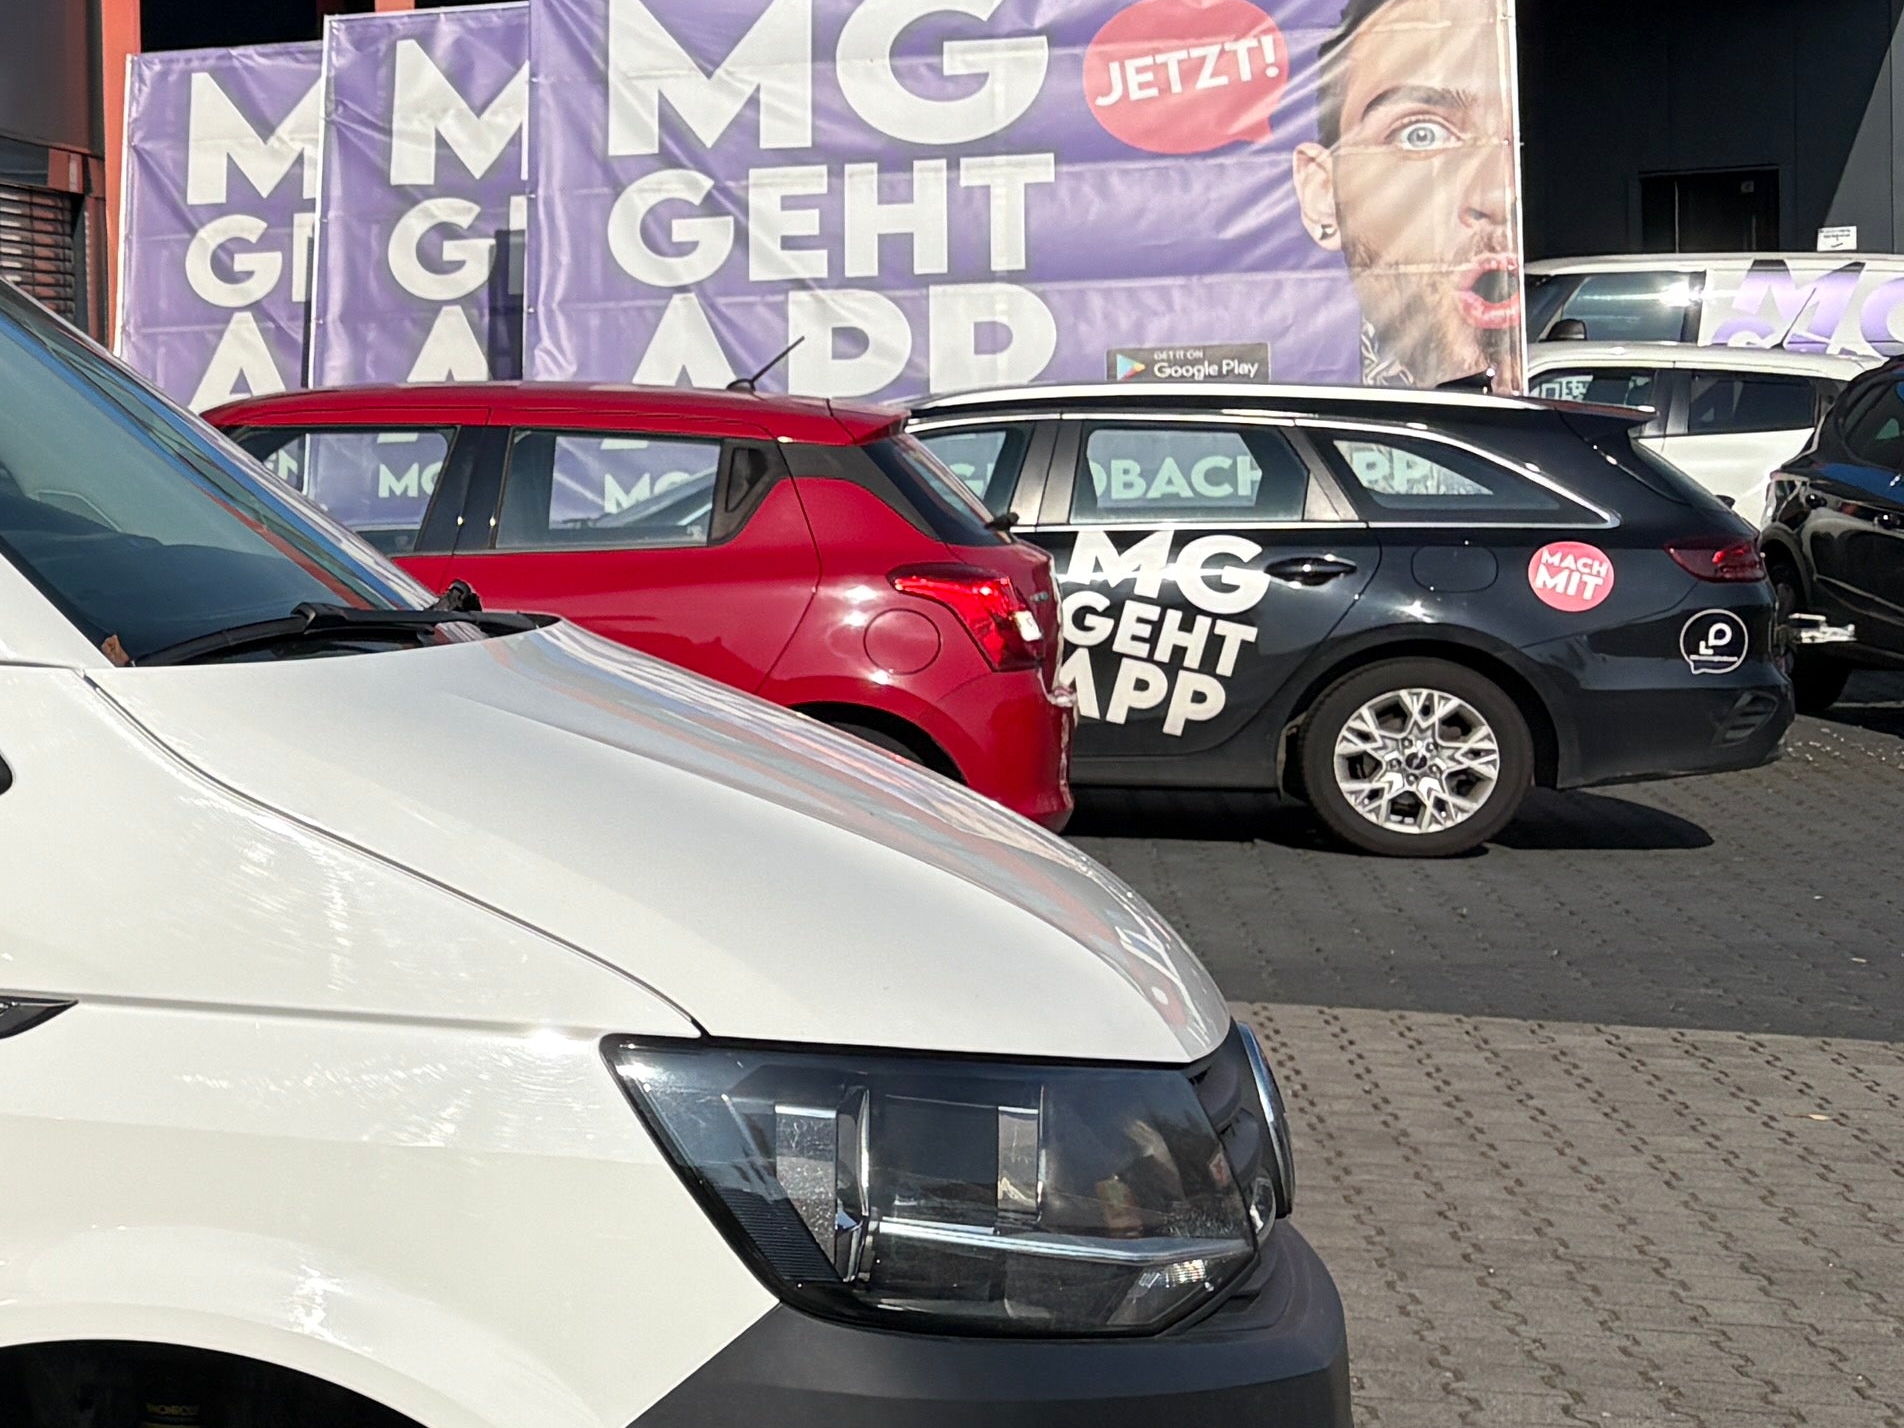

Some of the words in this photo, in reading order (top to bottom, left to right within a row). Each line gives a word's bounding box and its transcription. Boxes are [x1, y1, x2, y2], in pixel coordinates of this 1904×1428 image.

[1094, 34, 1280, 106] JETZT!
[607, 152, 1055, 287] GEHT
[1153, 360, 1219, 381] Google
[1222, 358, 1259, 379] Play
[1066, 529, 1271, 614] MG
[1534, 563, 1605, 602] MIT
[1541, 547, 1609, 578] MACH
[1062, 590, 1258, 678] GEHT
[1059, 647, 1226, 737] APP
